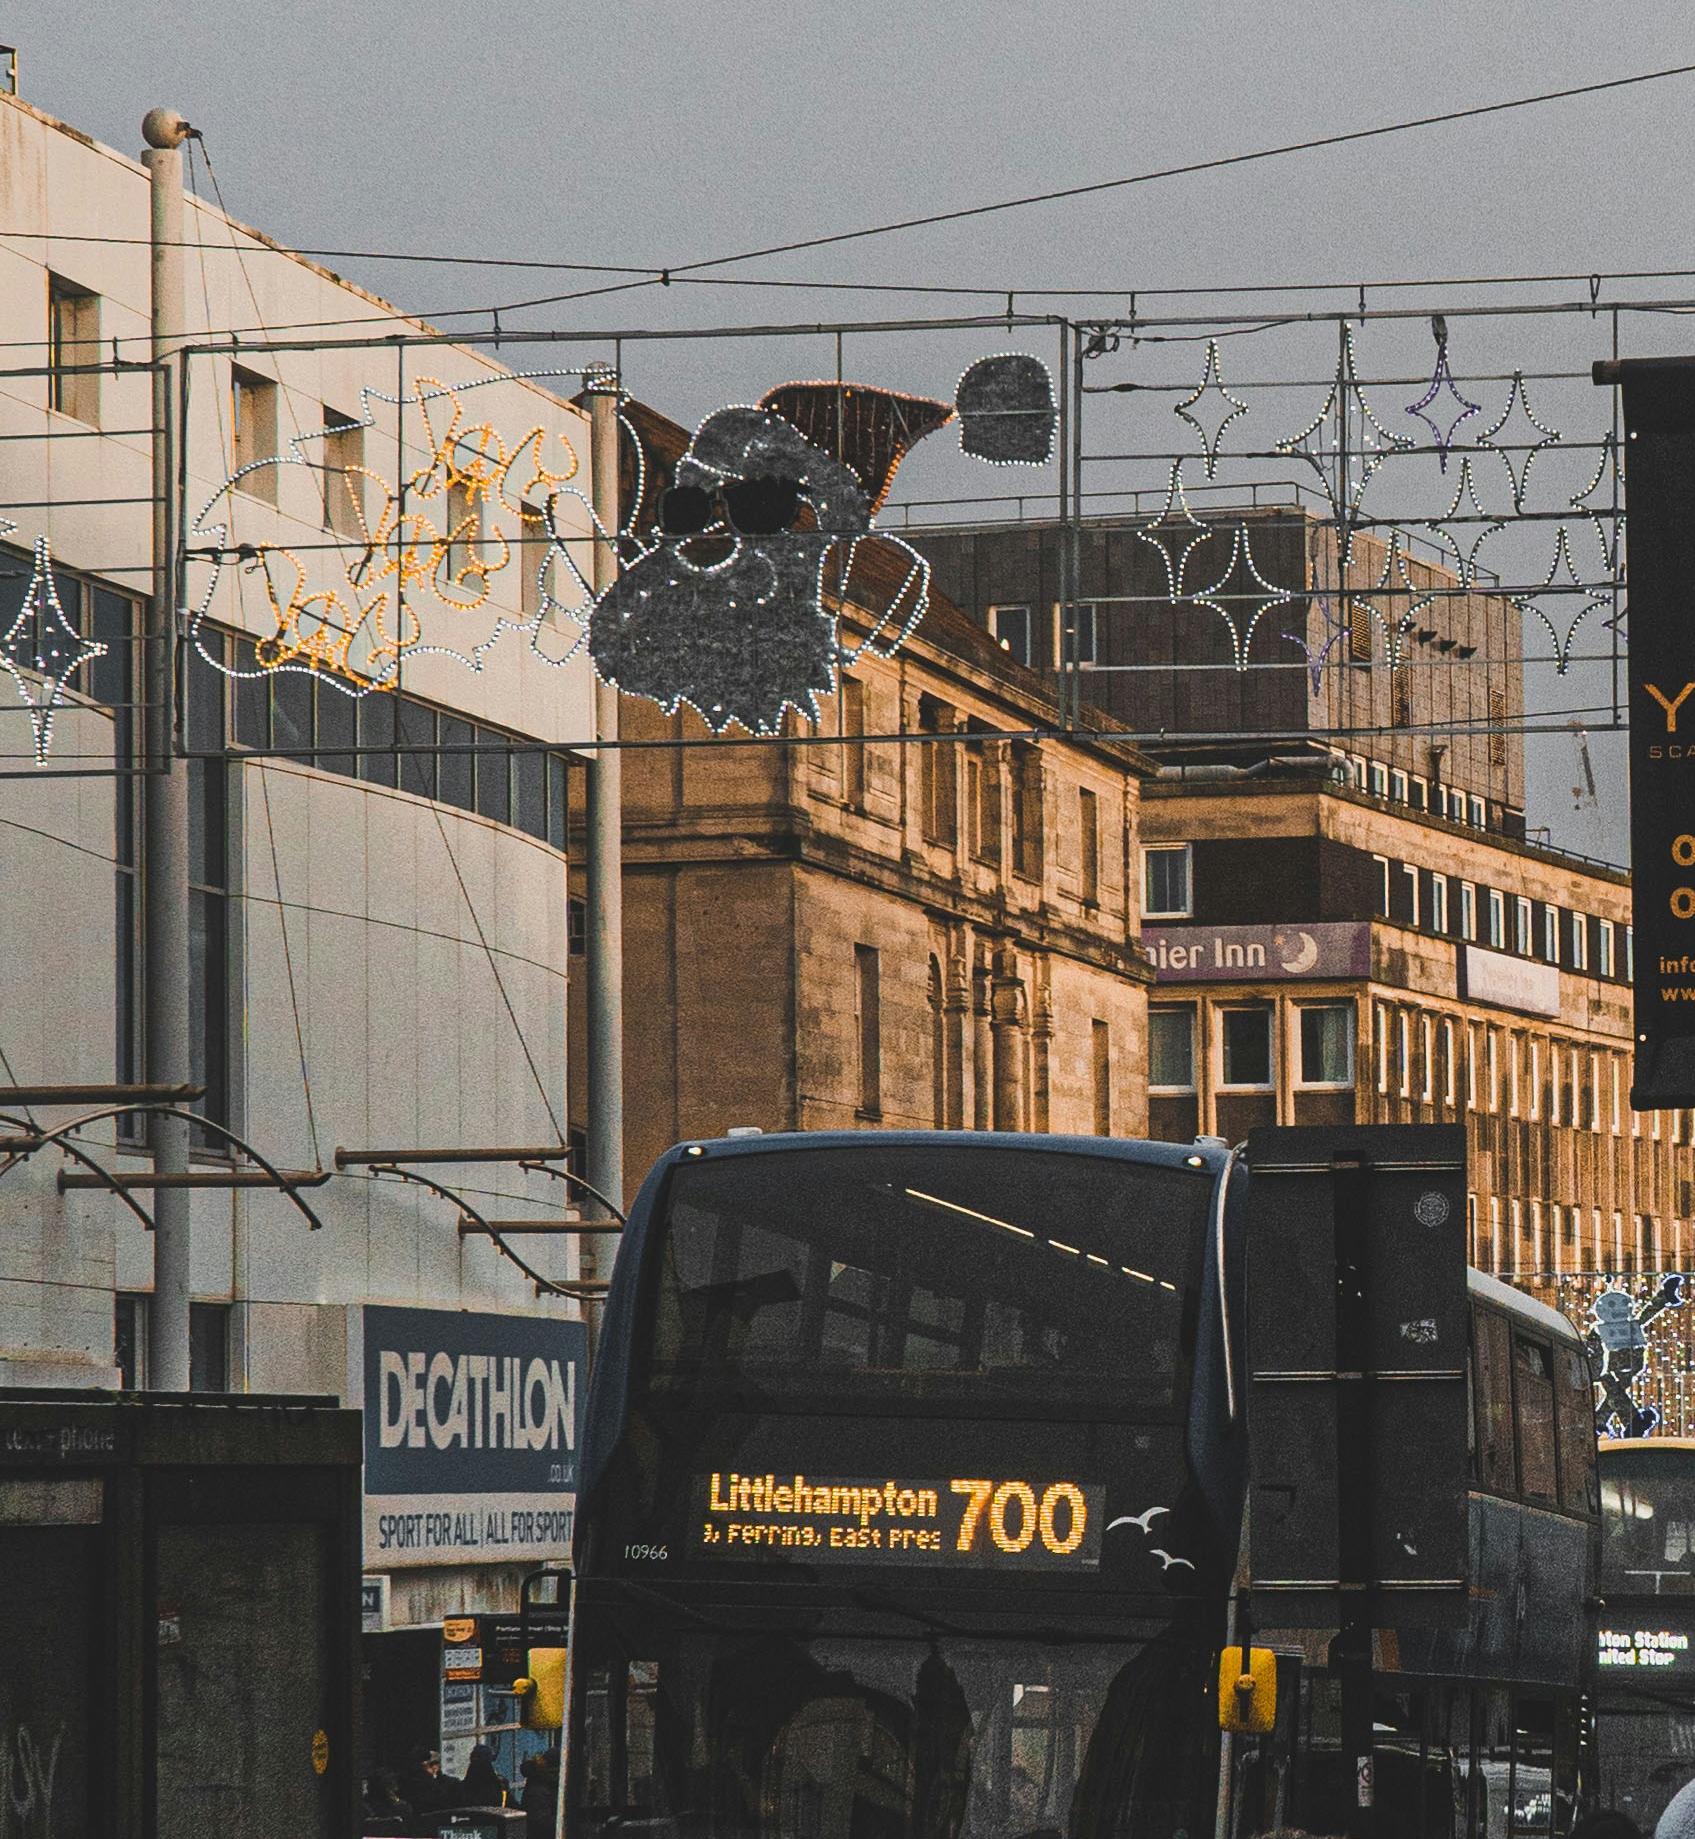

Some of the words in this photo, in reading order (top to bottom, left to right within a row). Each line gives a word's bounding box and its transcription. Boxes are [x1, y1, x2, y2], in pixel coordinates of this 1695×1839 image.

[1215, 937, 1266, 968] Inn
[379, 1350, 576, 1450] DECATHLON
[379, 1514, 423, 1549] SPORT
[425, 1513, 451, 1547] FOR
[453, 1512, 479, 1546] ALL
[486, 1512, 509, 1545] ALL
[511, 1512, 534, 1543] FOR
[534, 1510, 573, 1543] SPORT
[709, 1473, 938, 1526] Littlehampton
[950, 1480, 1087, 1555] 700
[624, 1544, 668, 1561] 10966
[830, 1527, 881, 1548] East
[1634, 1631, 1688, 1649] Station
